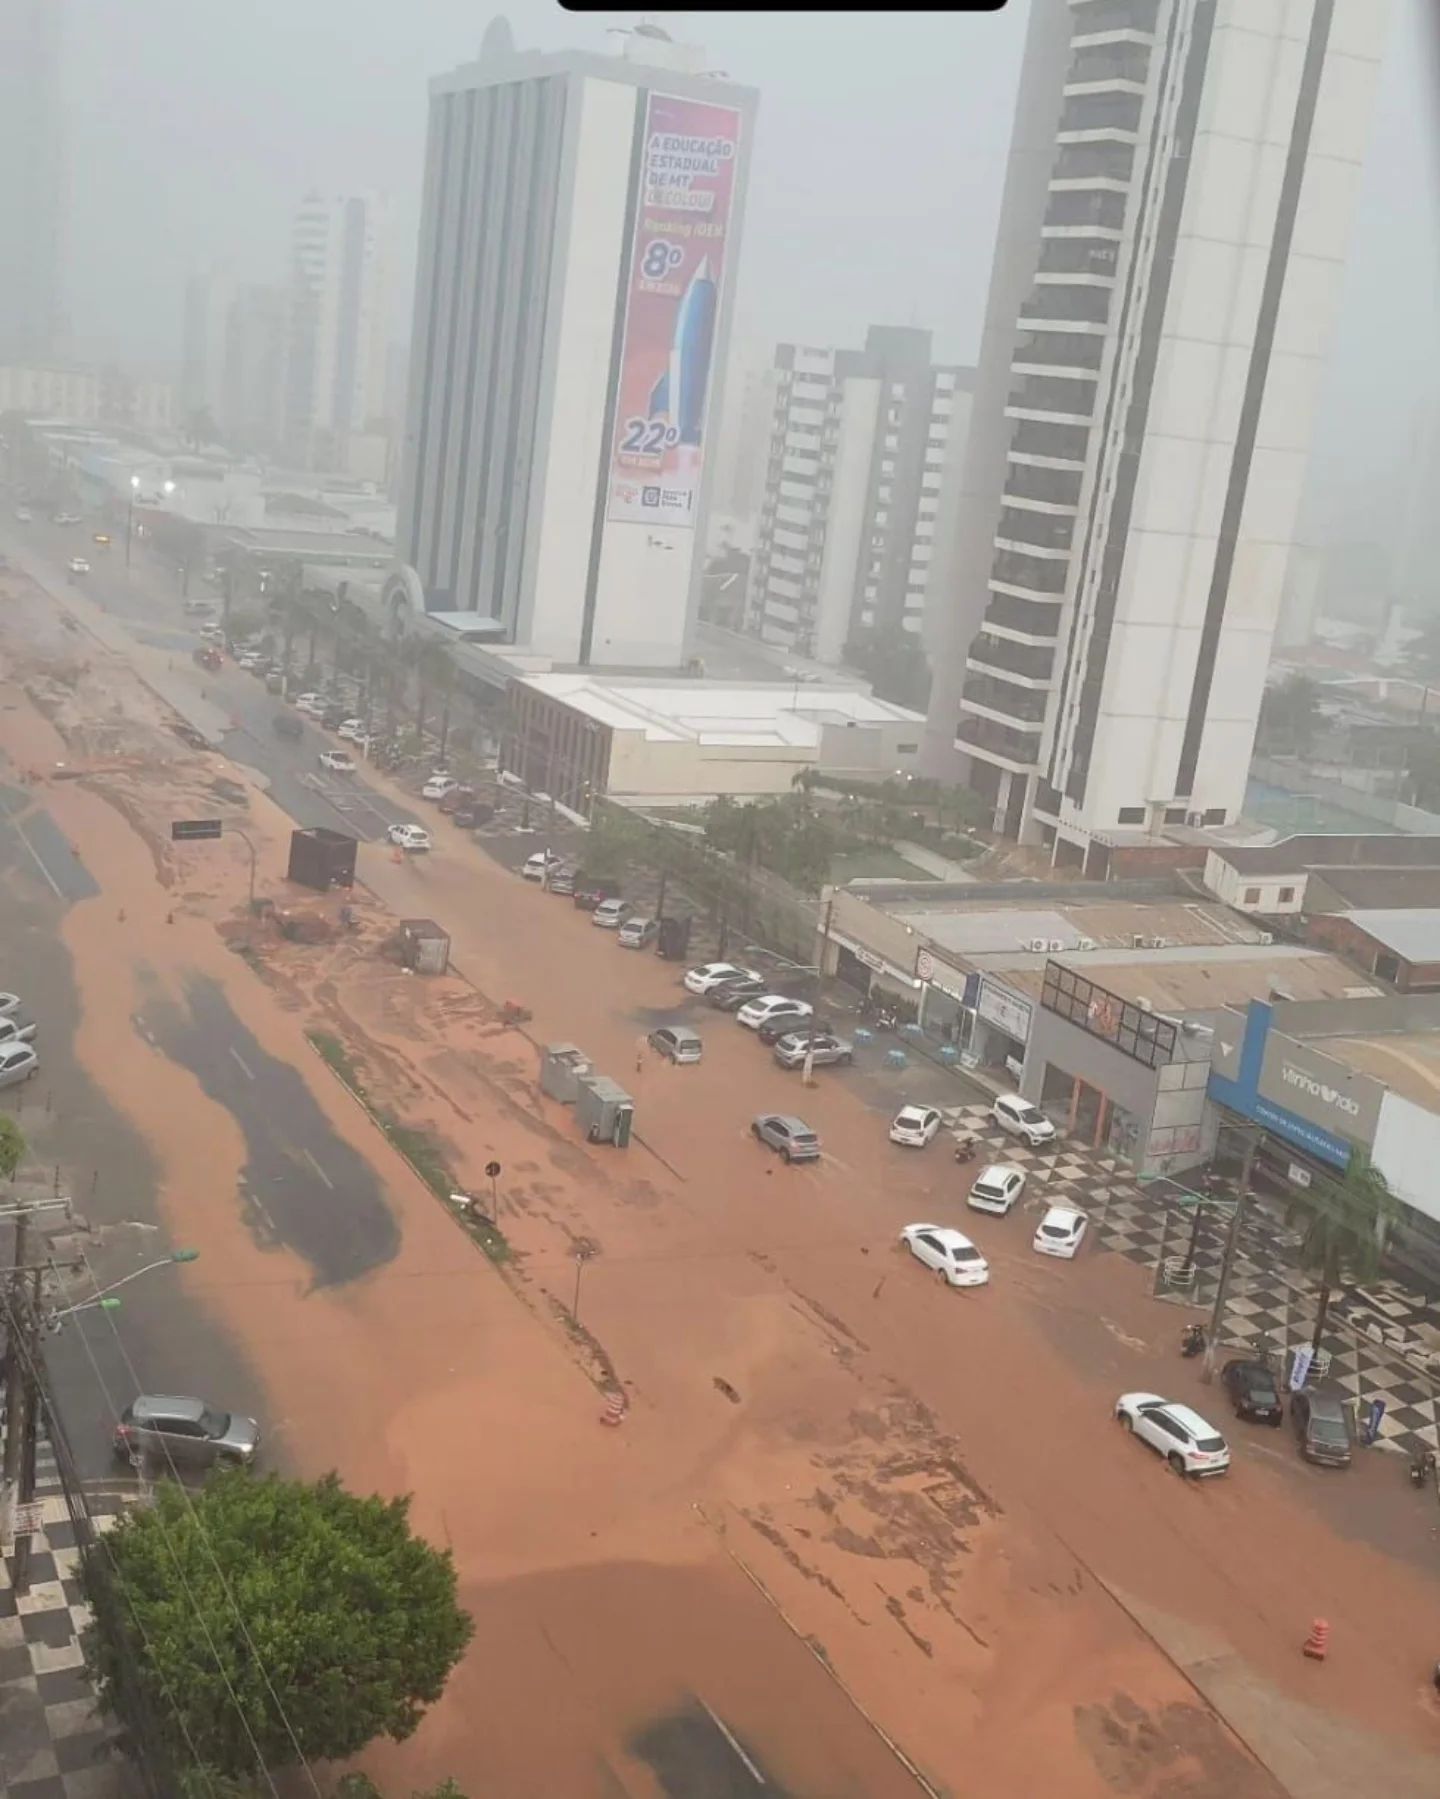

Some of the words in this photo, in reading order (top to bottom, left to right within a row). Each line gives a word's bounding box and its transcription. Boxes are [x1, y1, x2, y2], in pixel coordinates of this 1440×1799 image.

[651, 136, 660, 149] A
[663, 137, 732, 156] EDUCAÇÃO
[651, 154, 717, 173] ESTADUAL
[649, 172, 666, 185] DE
[669, 174, 690, 187] MT
